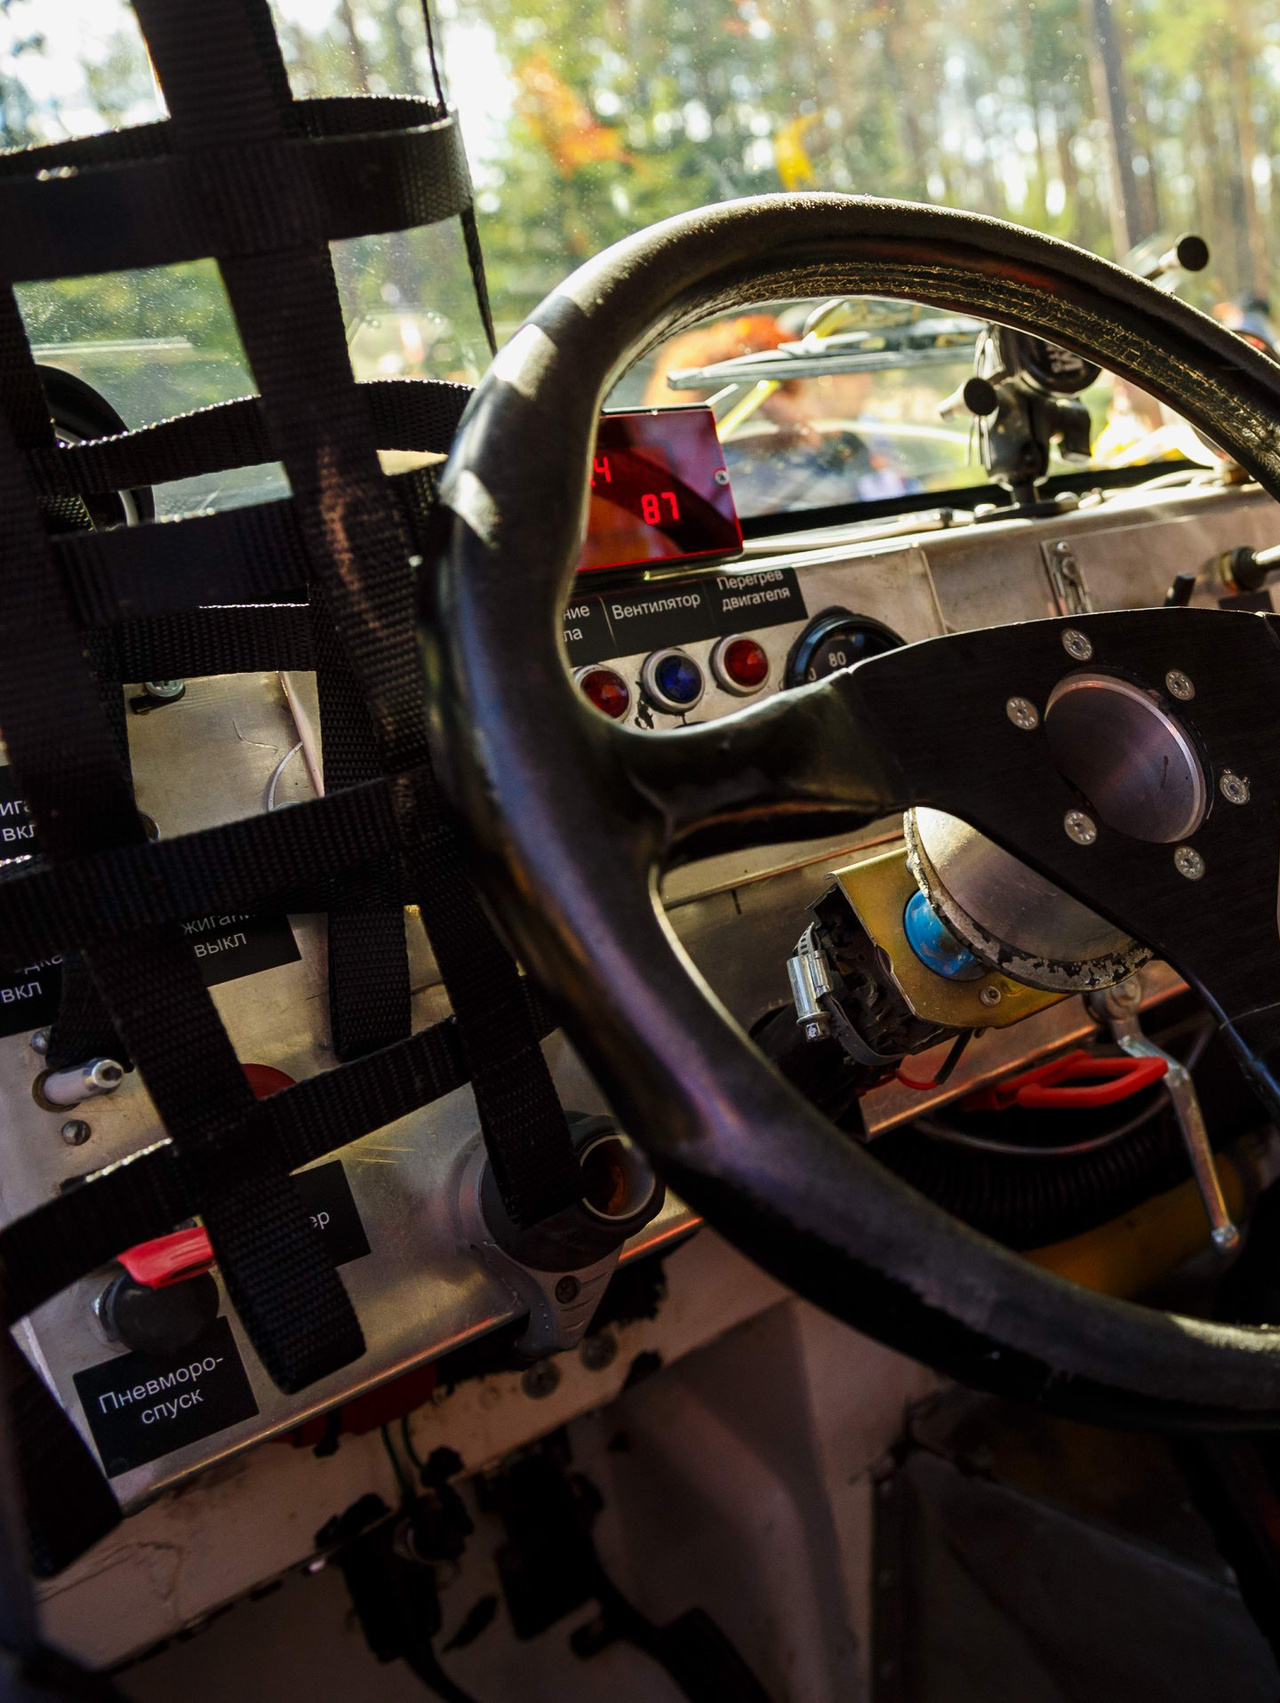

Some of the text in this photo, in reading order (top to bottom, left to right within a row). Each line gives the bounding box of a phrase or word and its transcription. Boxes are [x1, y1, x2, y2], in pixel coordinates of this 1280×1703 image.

[641, 491, 680, 525] 87
[716, 570, 784, 591] Перегрев
[611, 593, 701, 620] Вентилятор
[722, 586, 791, 612] двигателя
[828, 650, 847, 668] 80
[193, 932, 247, 958] выкл
[98, 1356, 225, 1414] Пневморо-
[141, 1388, 204, 1425] спуск
